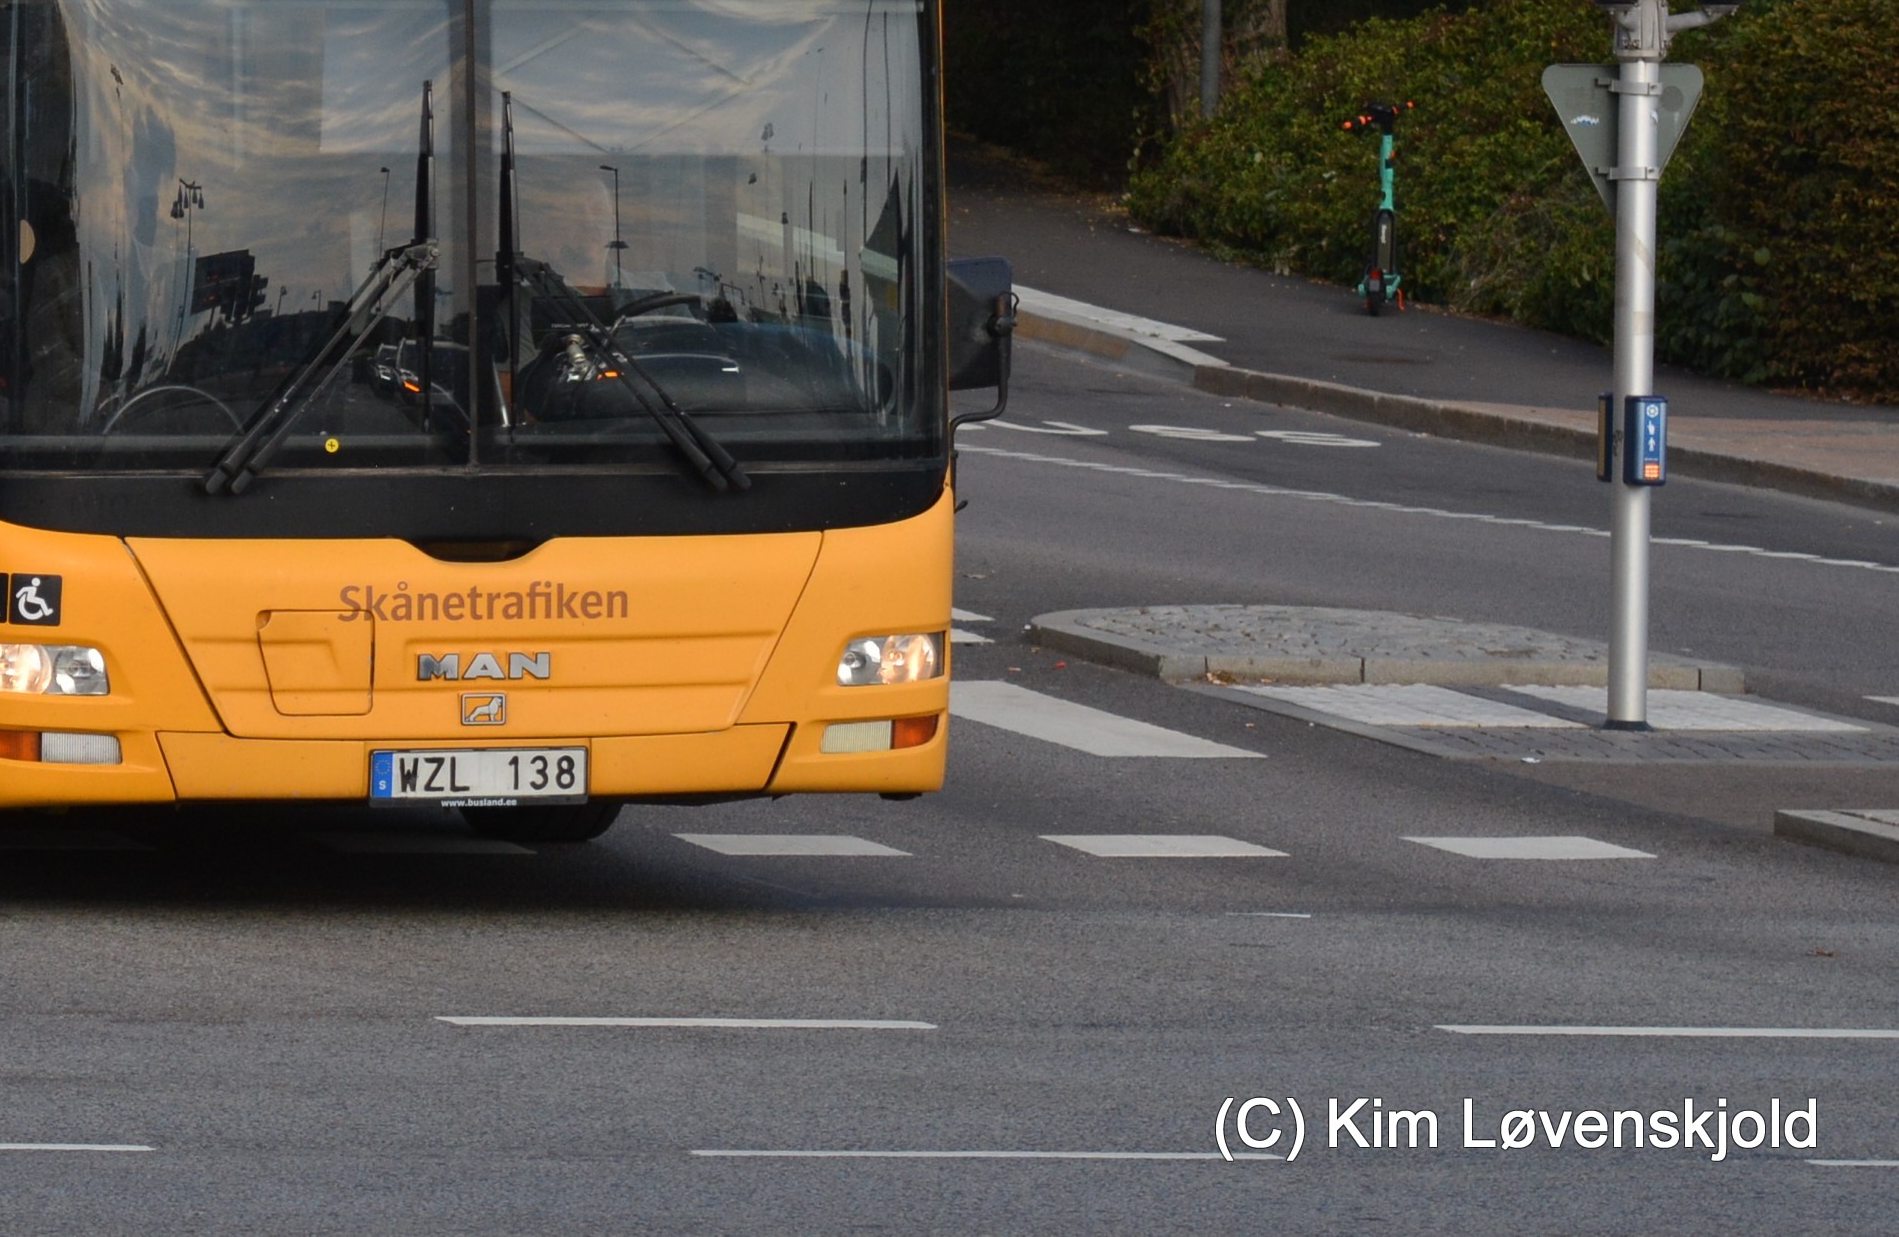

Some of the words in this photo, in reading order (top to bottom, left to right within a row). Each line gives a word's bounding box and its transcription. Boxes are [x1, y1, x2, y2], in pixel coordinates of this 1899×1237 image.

[337, 581, 628, 623] Skånetrafiken
[416, 652, 550, 681] MAN
[378, 780, 387, 790] S
[399, 756, 470, 793] WZL
[508, 755, 575, 791] 138
[441, 797, 517, 807] www.busland.ee
